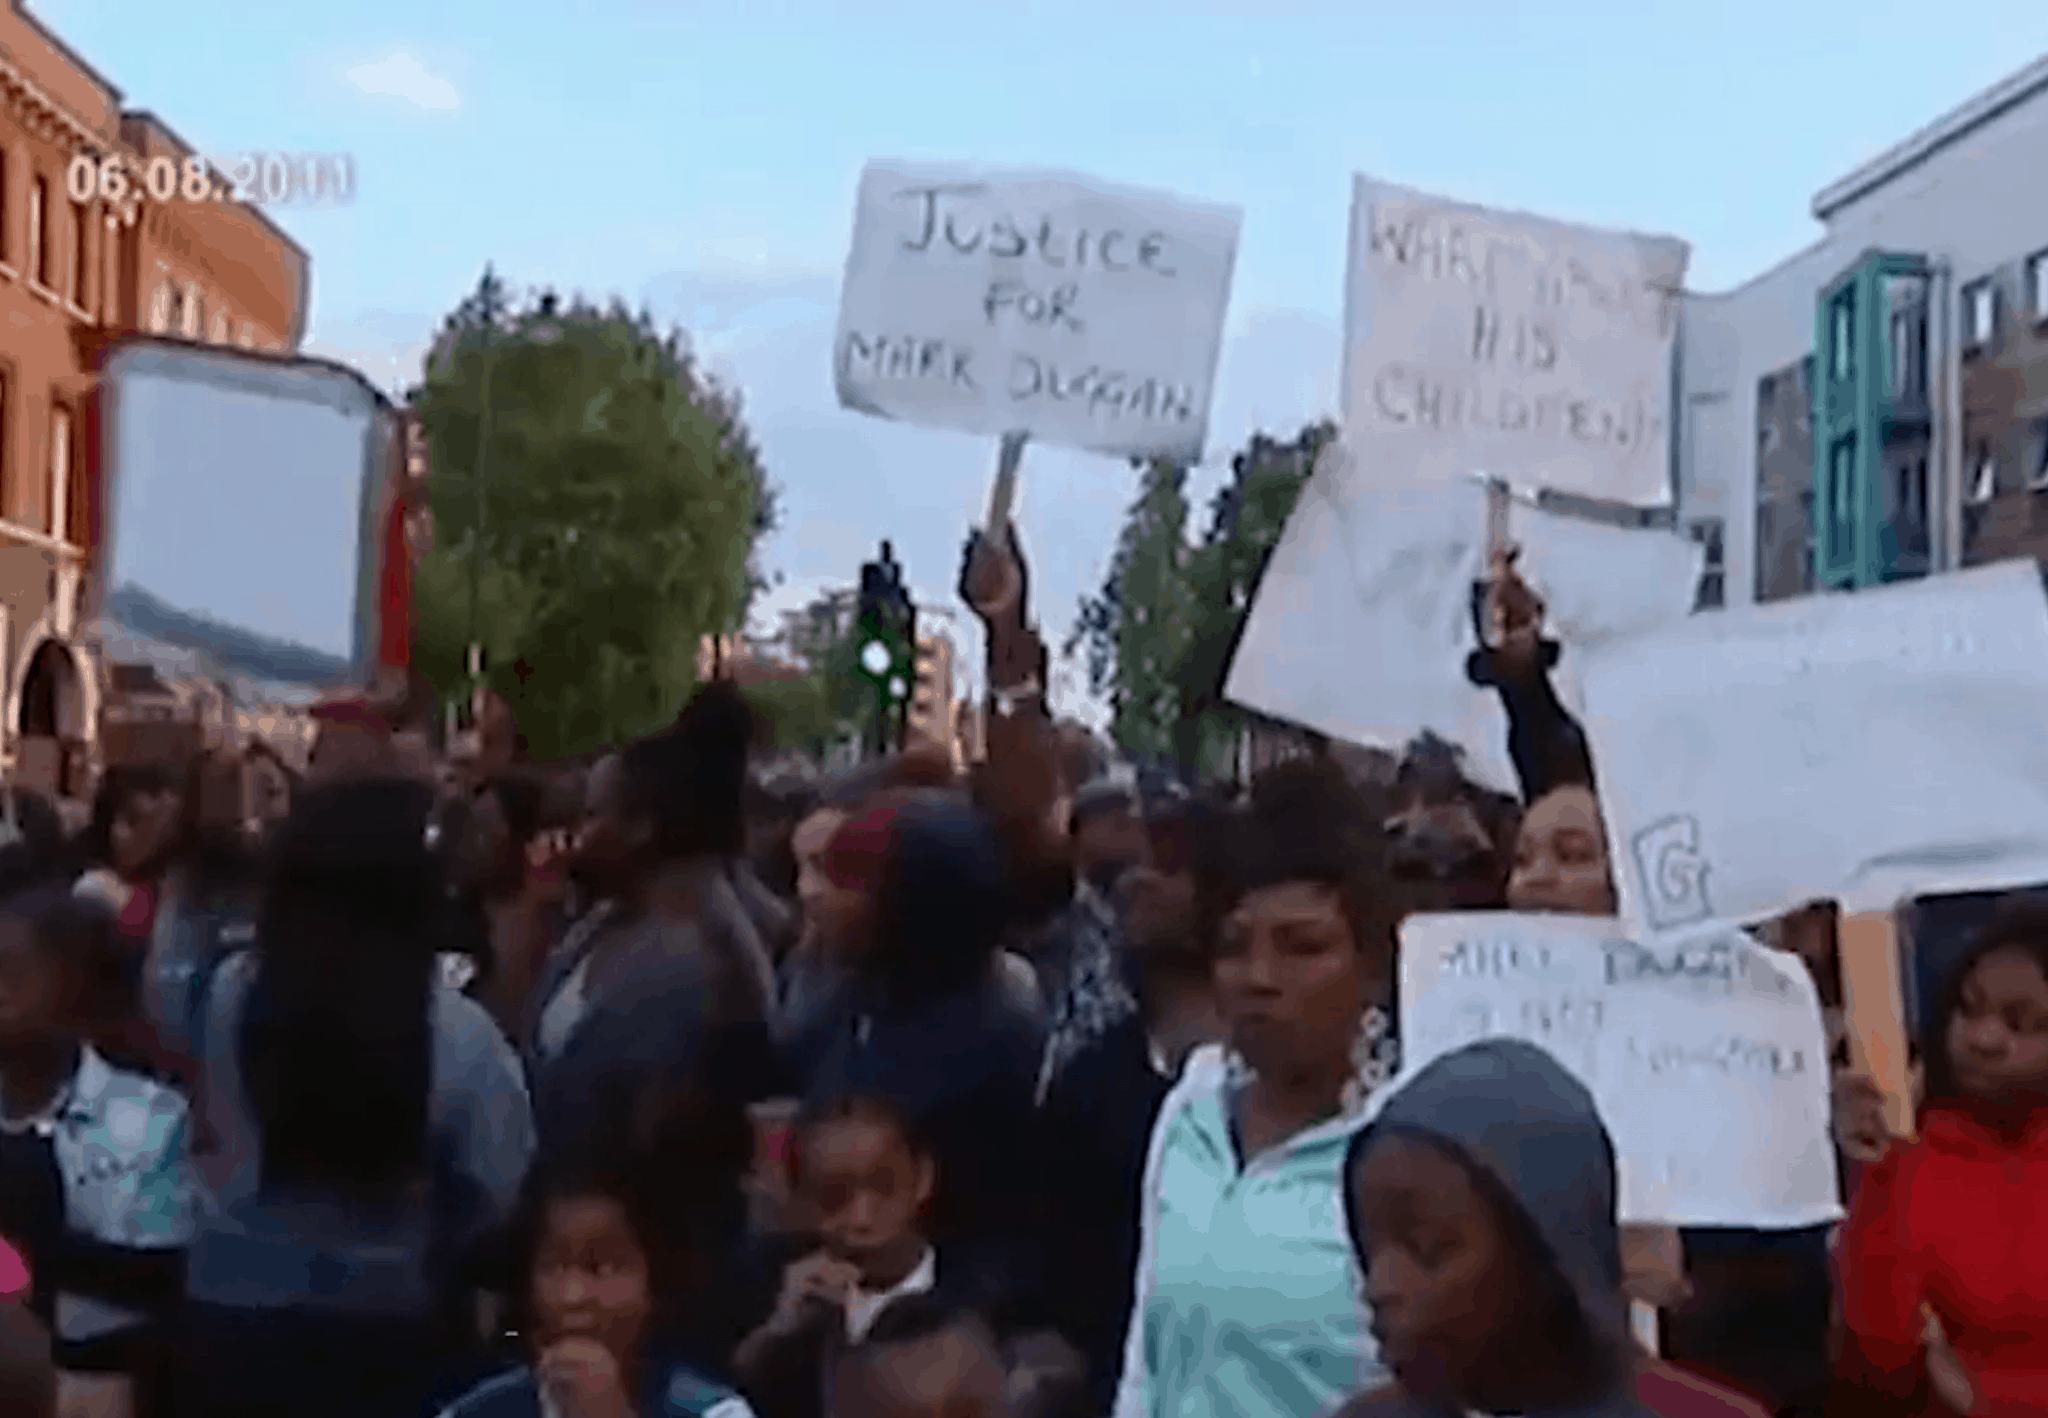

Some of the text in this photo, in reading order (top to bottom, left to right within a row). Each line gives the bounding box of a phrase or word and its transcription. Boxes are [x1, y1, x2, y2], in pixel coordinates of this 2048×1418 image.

[893, 182, 1178, 278] JUSTICE
[981, 277, 1085, 334] FOR
[1471, 304, 1558, 373] HIS
[842, 330, 1195, 424] MARK DUGGAN
